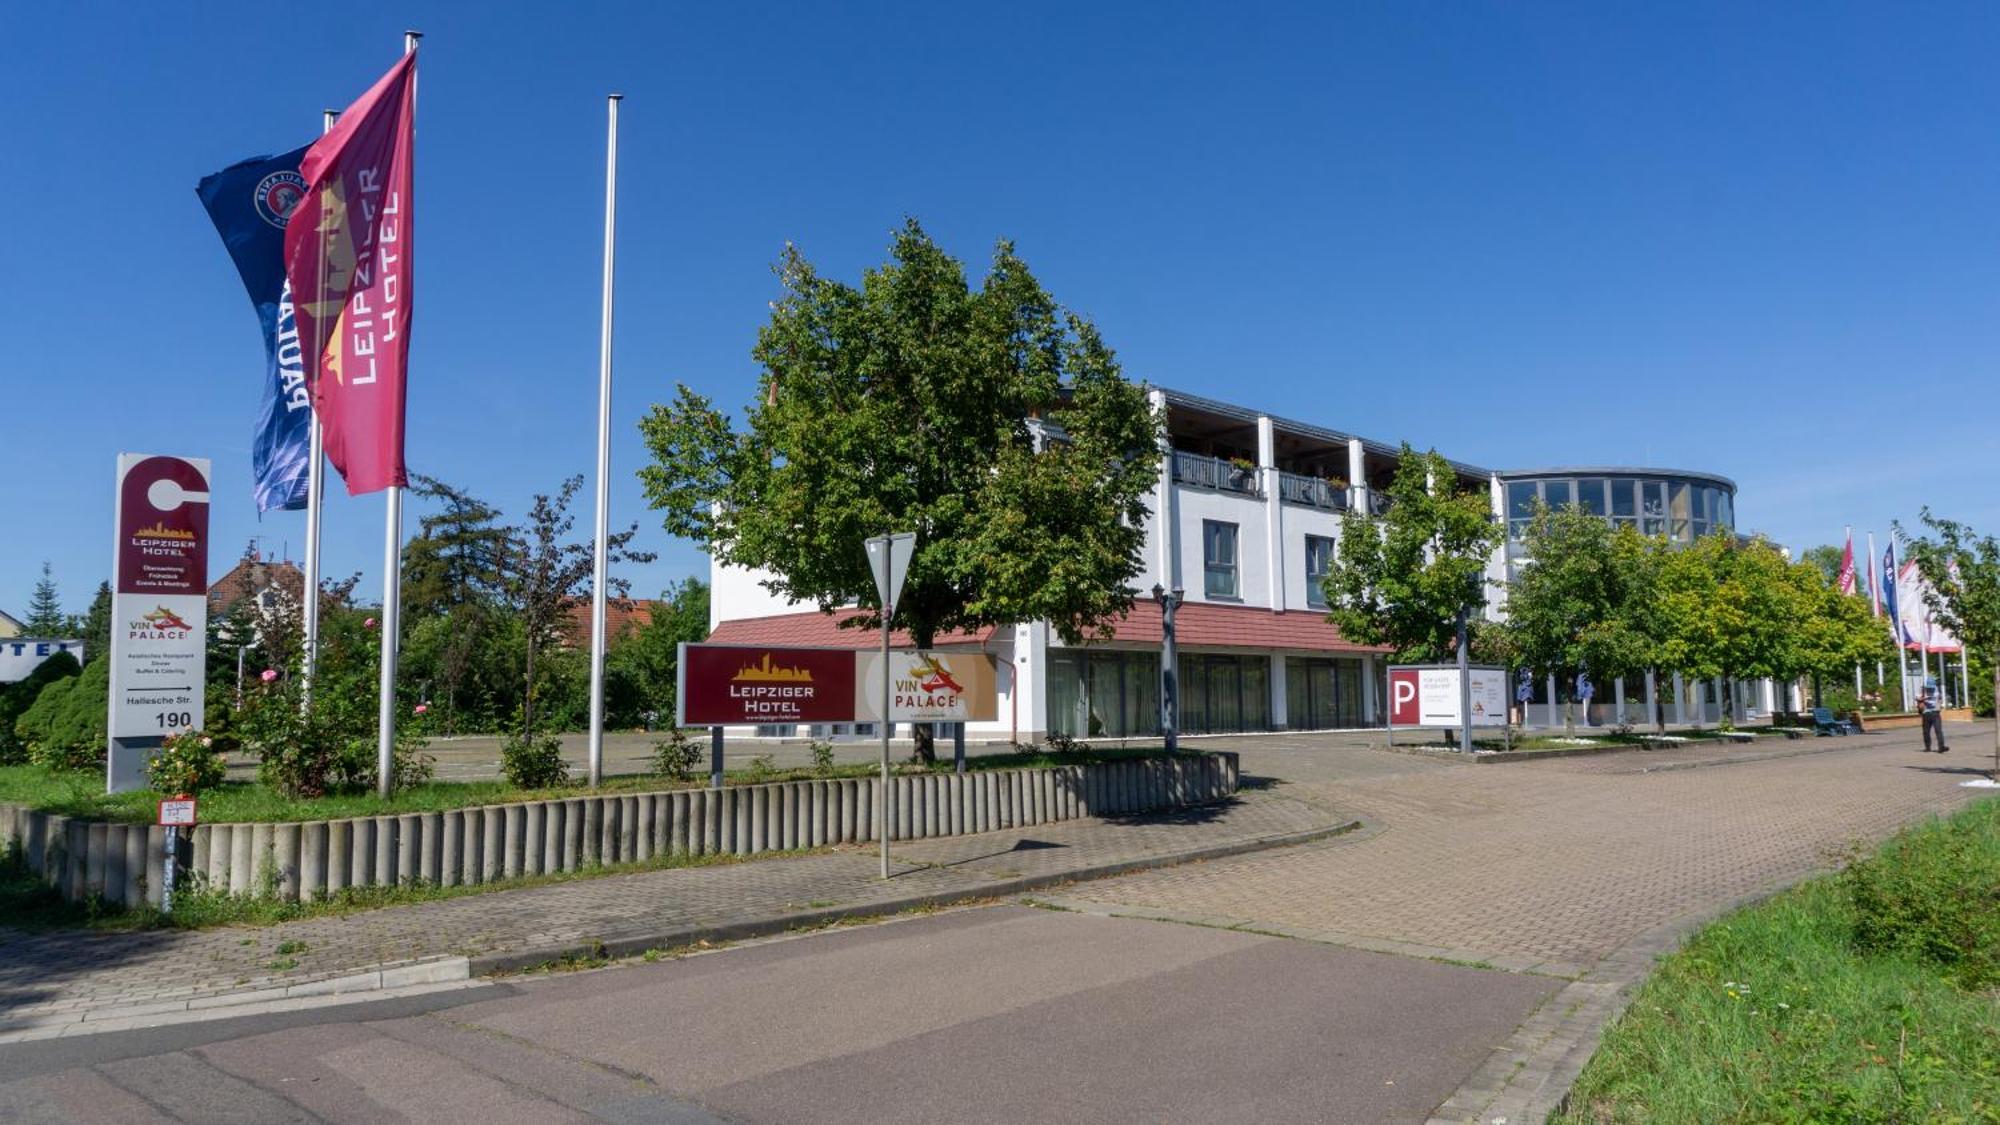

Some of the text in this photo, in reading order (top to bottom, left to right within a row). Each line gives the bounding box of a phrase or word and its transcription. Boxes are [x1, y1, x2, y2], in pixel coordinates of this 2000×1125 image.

[379, 191, 398, 342] HOTEL
[131, 538, 196, 549] LEIPZIGER
[142, 547, 185, 557] HOTEL
[130, 621, 150, 630] VIN
[129, 631, 185, 639] PALACE
[730, 685, 814, 697] LEIPZIGER
[895, 680, 917, 692] VIN
[127, 696, 192, 705] Hallesche Str.
[895, 695, 957, 707] PALACE
[1394, 680, 1416, 715] P
[744, 701, 801, 713] HOTEL
[156, 712, 191, 728] 190
